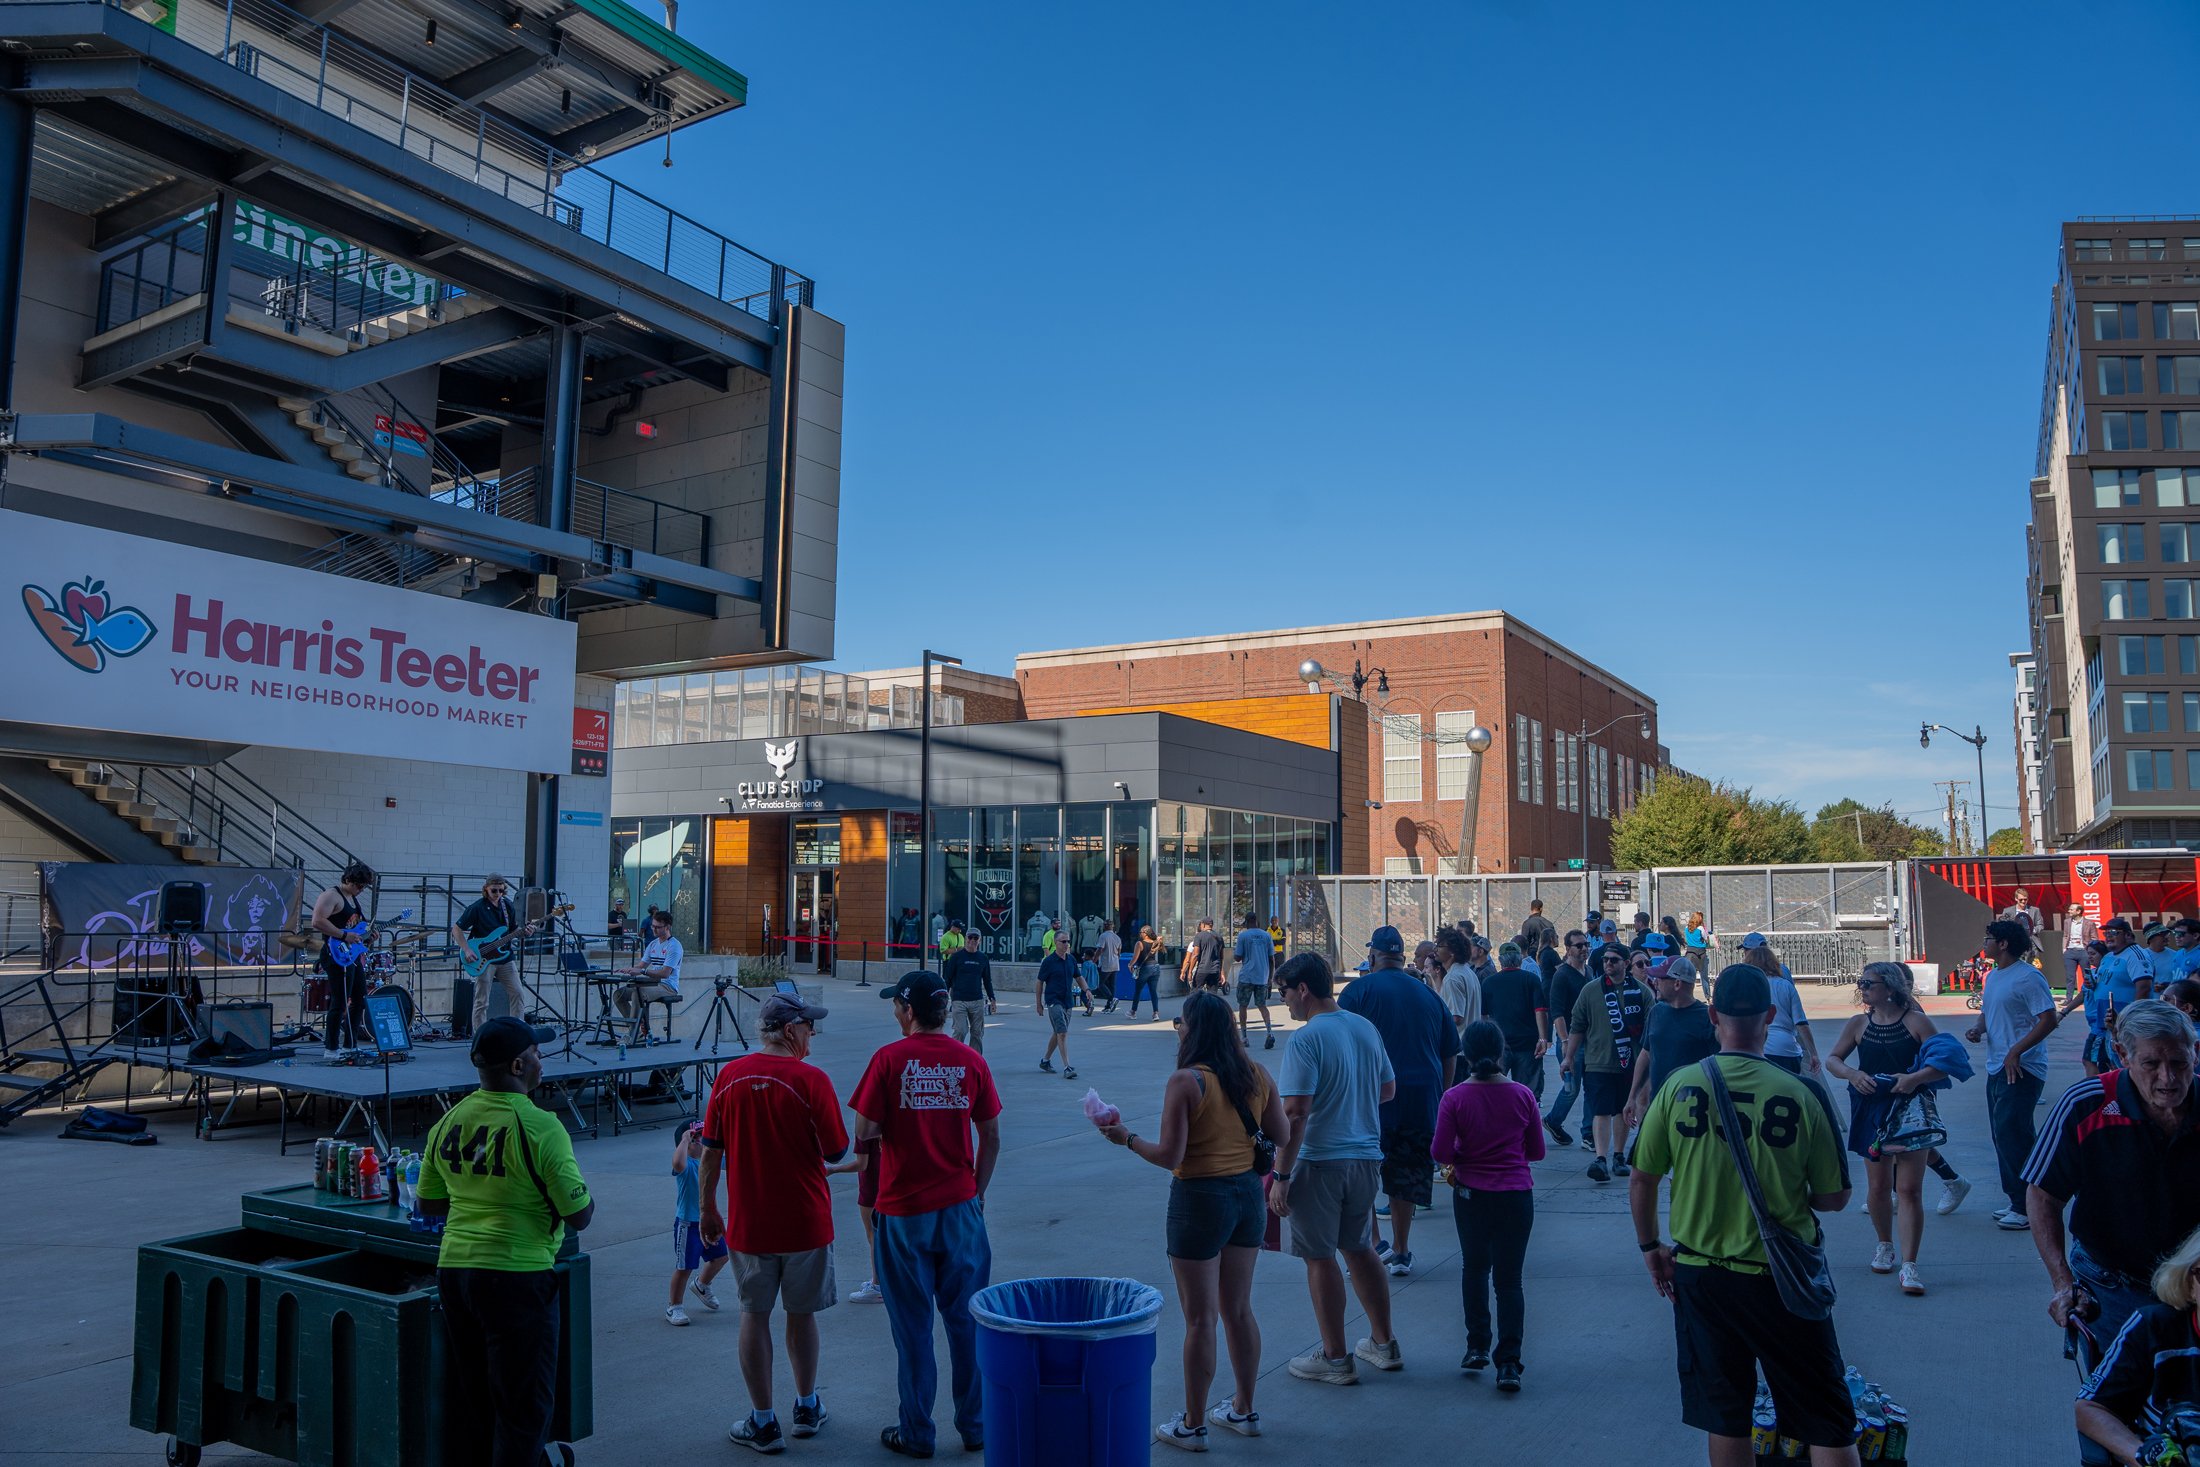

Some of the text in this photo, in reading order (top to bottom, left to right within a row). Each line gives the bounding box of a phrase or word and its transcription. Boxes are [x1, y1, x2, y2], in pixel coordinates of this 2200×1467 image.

[171, 592, 540, 703] Harris Teeter
[169, 667, 528, 730] YOUR NEIGHBORHOOD MARKET
[738, 779, 824, 796] CLUB SHOP
[757, 800, 785, 809] Fanatics
[785, 800, 824, 808] Experience
[900, 1059, 966, 1079] Meadows
[900, 1077, 945, 1093] Farms
[439, 1124, 510, 1178] 441
